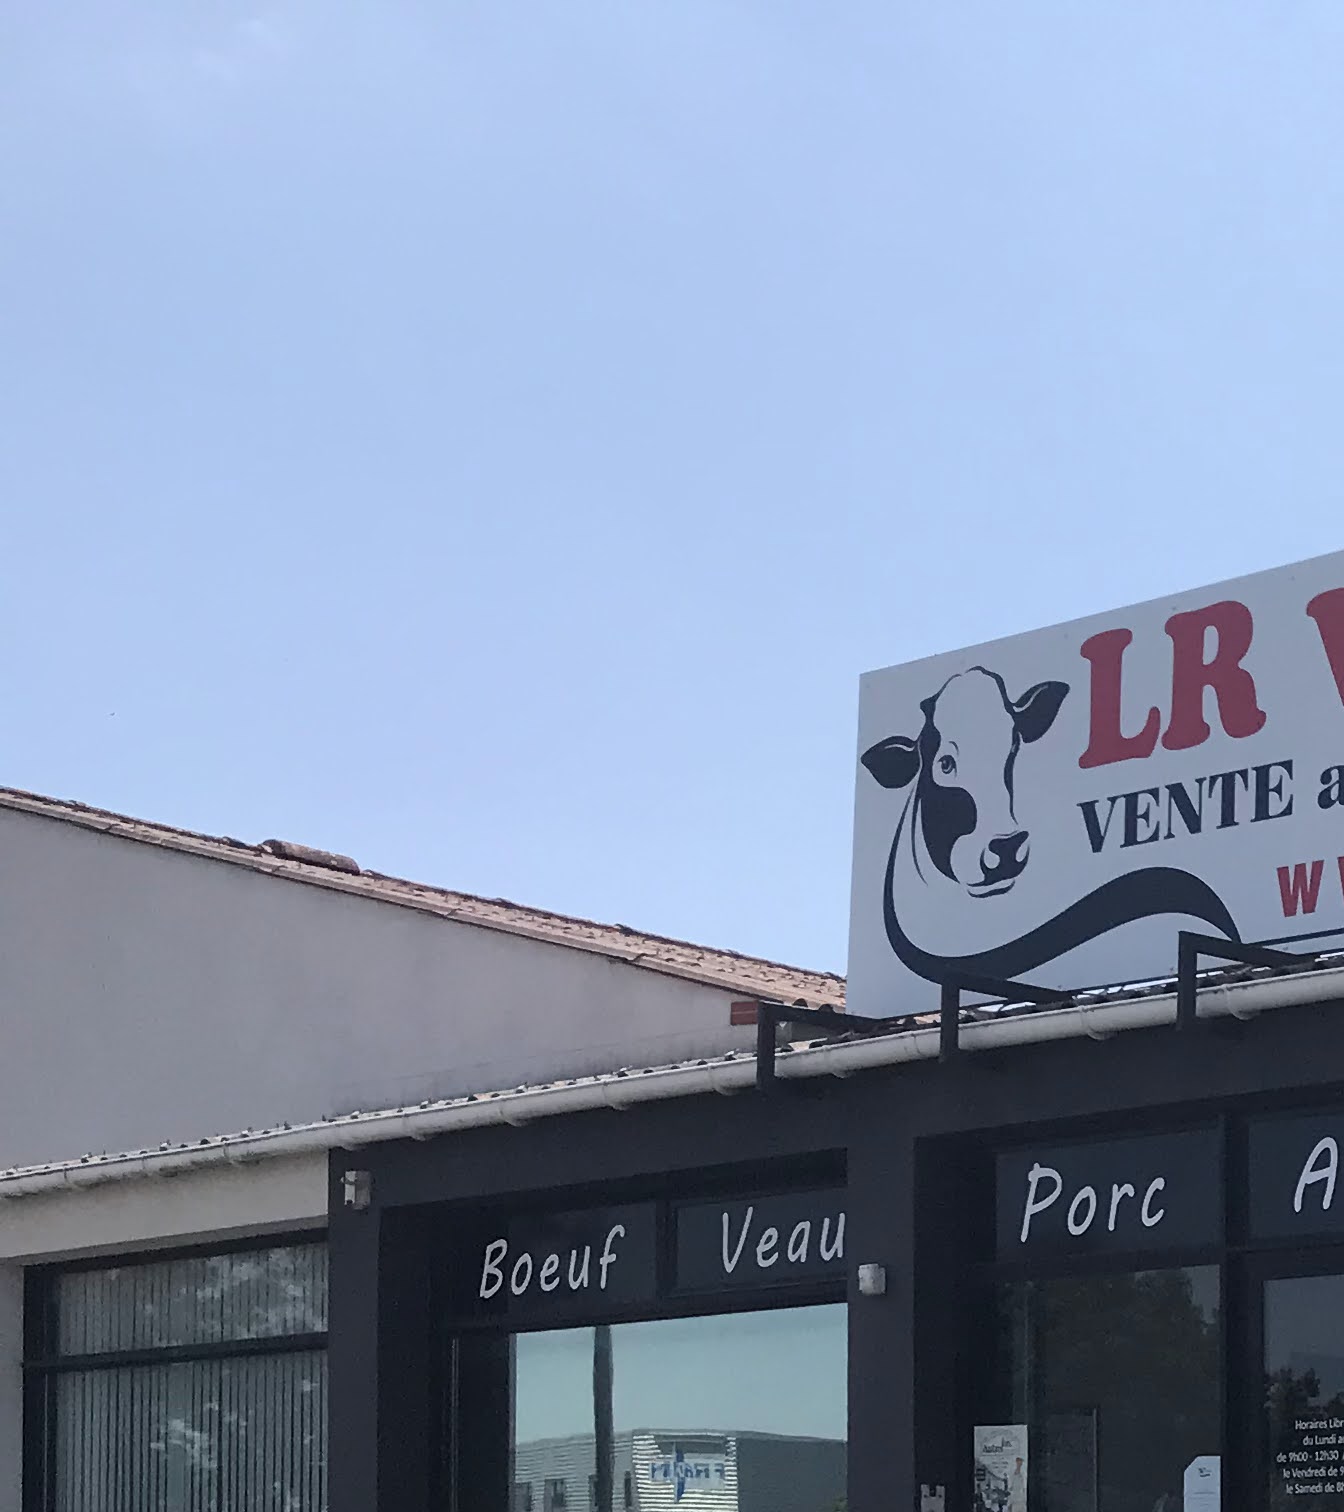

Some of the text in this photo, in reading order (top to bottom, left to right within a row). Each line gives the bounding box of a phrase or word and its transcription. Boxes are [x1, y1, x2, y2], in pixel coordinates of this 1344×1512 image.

[1079, 601, 1266, 768] LR
[1077, 760, 1293, 853] VENTE
[1021, 1163, 1165, 1242] Porc
[723, 1207, 845, 1273] Veau
[480, 1225, 625, 1298] Boeuf
[1295, 1419, 1327, 1430] Horaires
[1303, 1436, 1313, 1446] du
[1315, 1434, 1336, 1445] Lundi
[1276, 1452, 1287, 1463] de
[1288, 1451, 1308, 1462] 9h00
[1315, 1450, 1339, 1461] 12h30
[1283, 1468, 1290, 1478] le
[1291, 1467, 1326, 1478] Vendredi
[1327, 1466, 1338, 1477] de
[1286, 1484, 1293, 1494] le
[1295, 1482, 1323, 1494] Samedi
[1324, 1482, 1335, 1493] de
